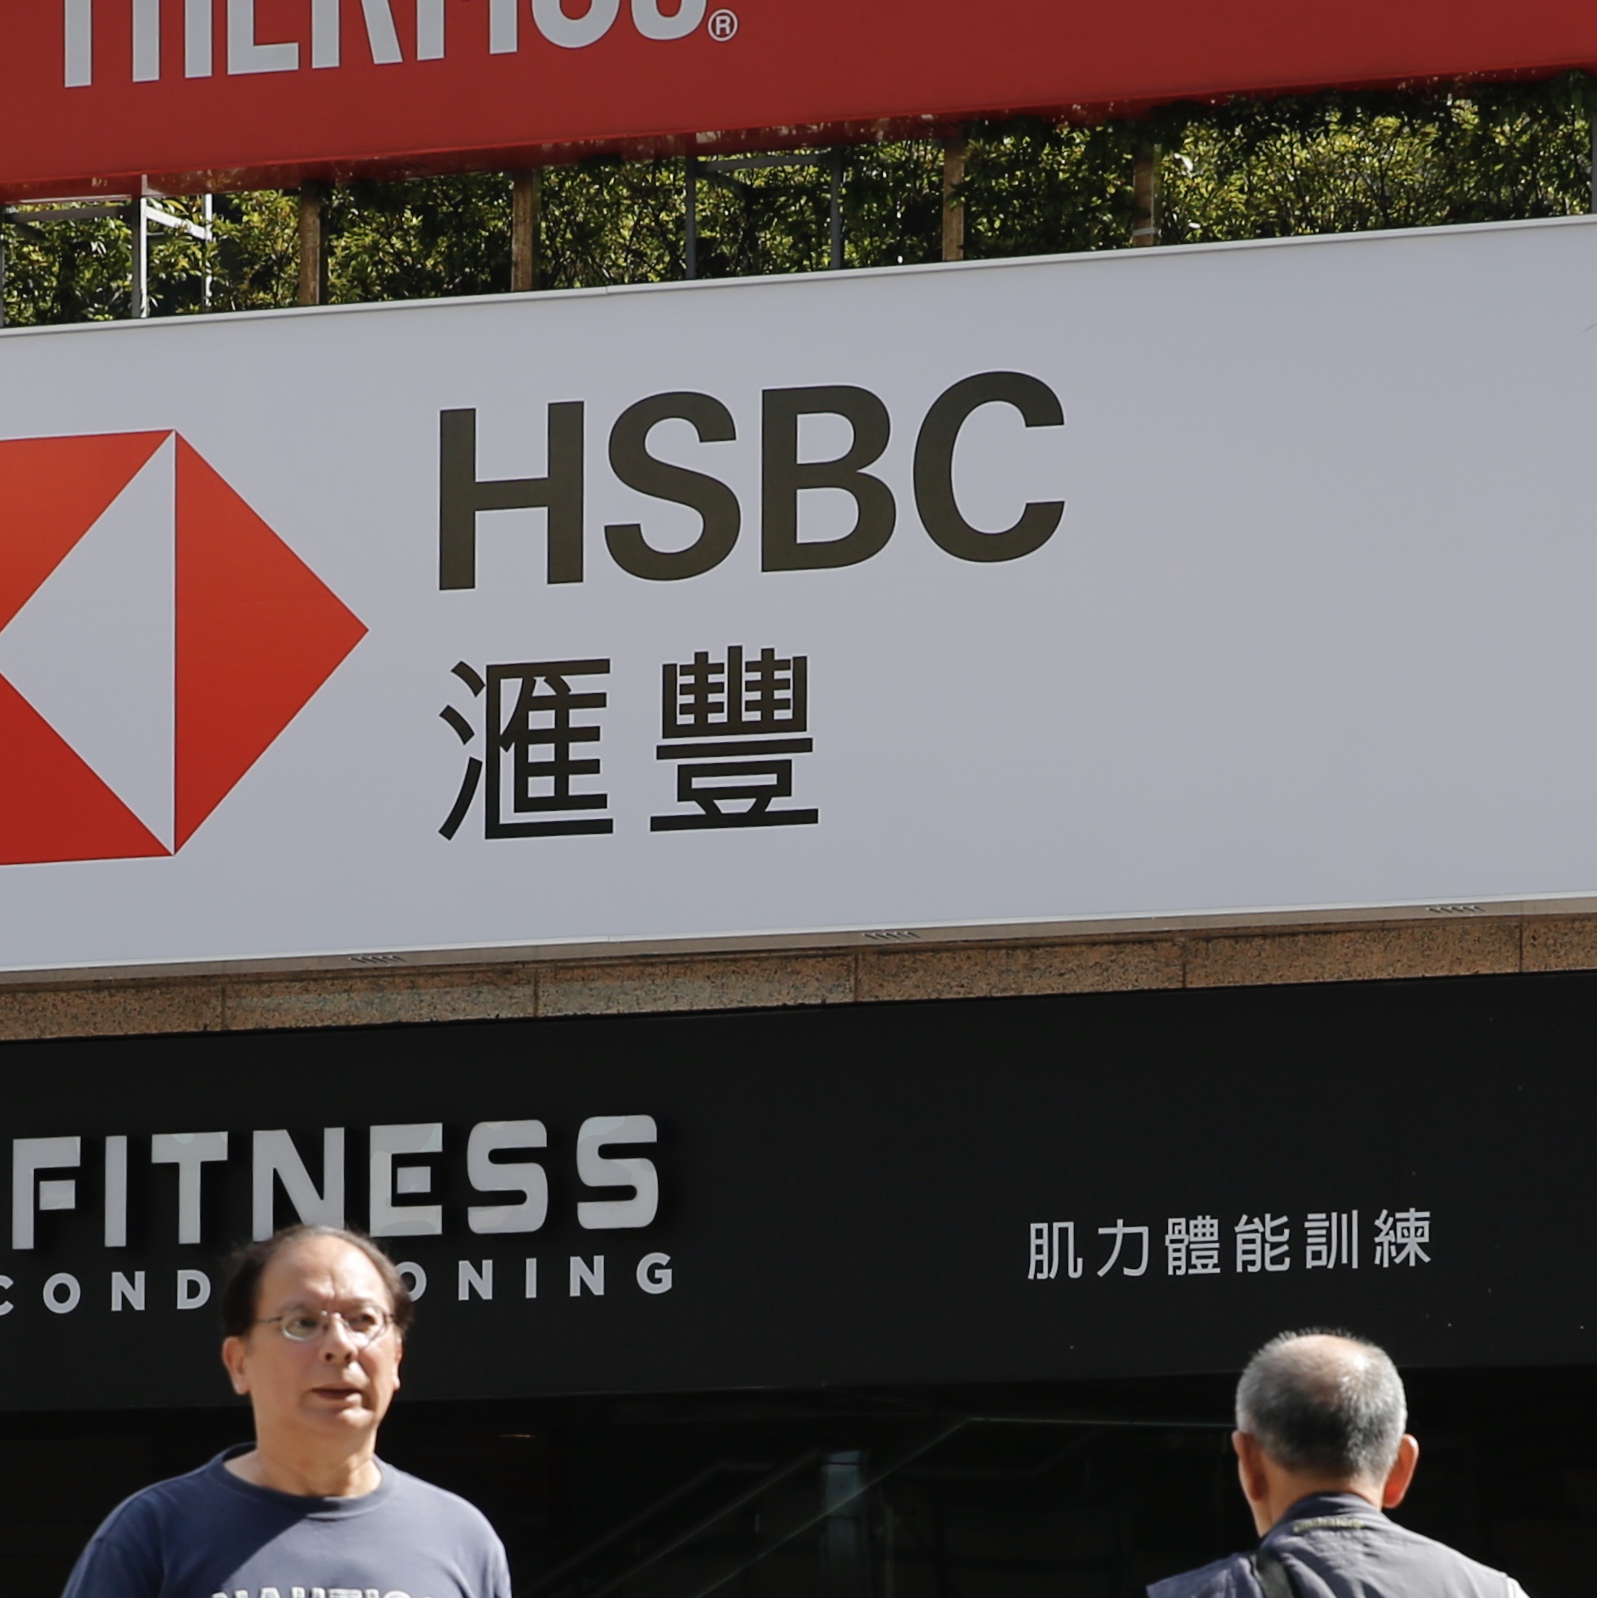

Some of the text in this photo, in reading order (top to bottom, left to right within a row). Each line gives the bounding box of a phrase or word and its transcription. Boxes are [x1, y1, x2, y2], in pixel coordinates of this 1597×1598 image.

[439, 371, 1065, 591] HSBC
[12, 1114, 659, 1250] FITNESS
[1027, 1207, 1431, 1280] 肌力體能訓練
